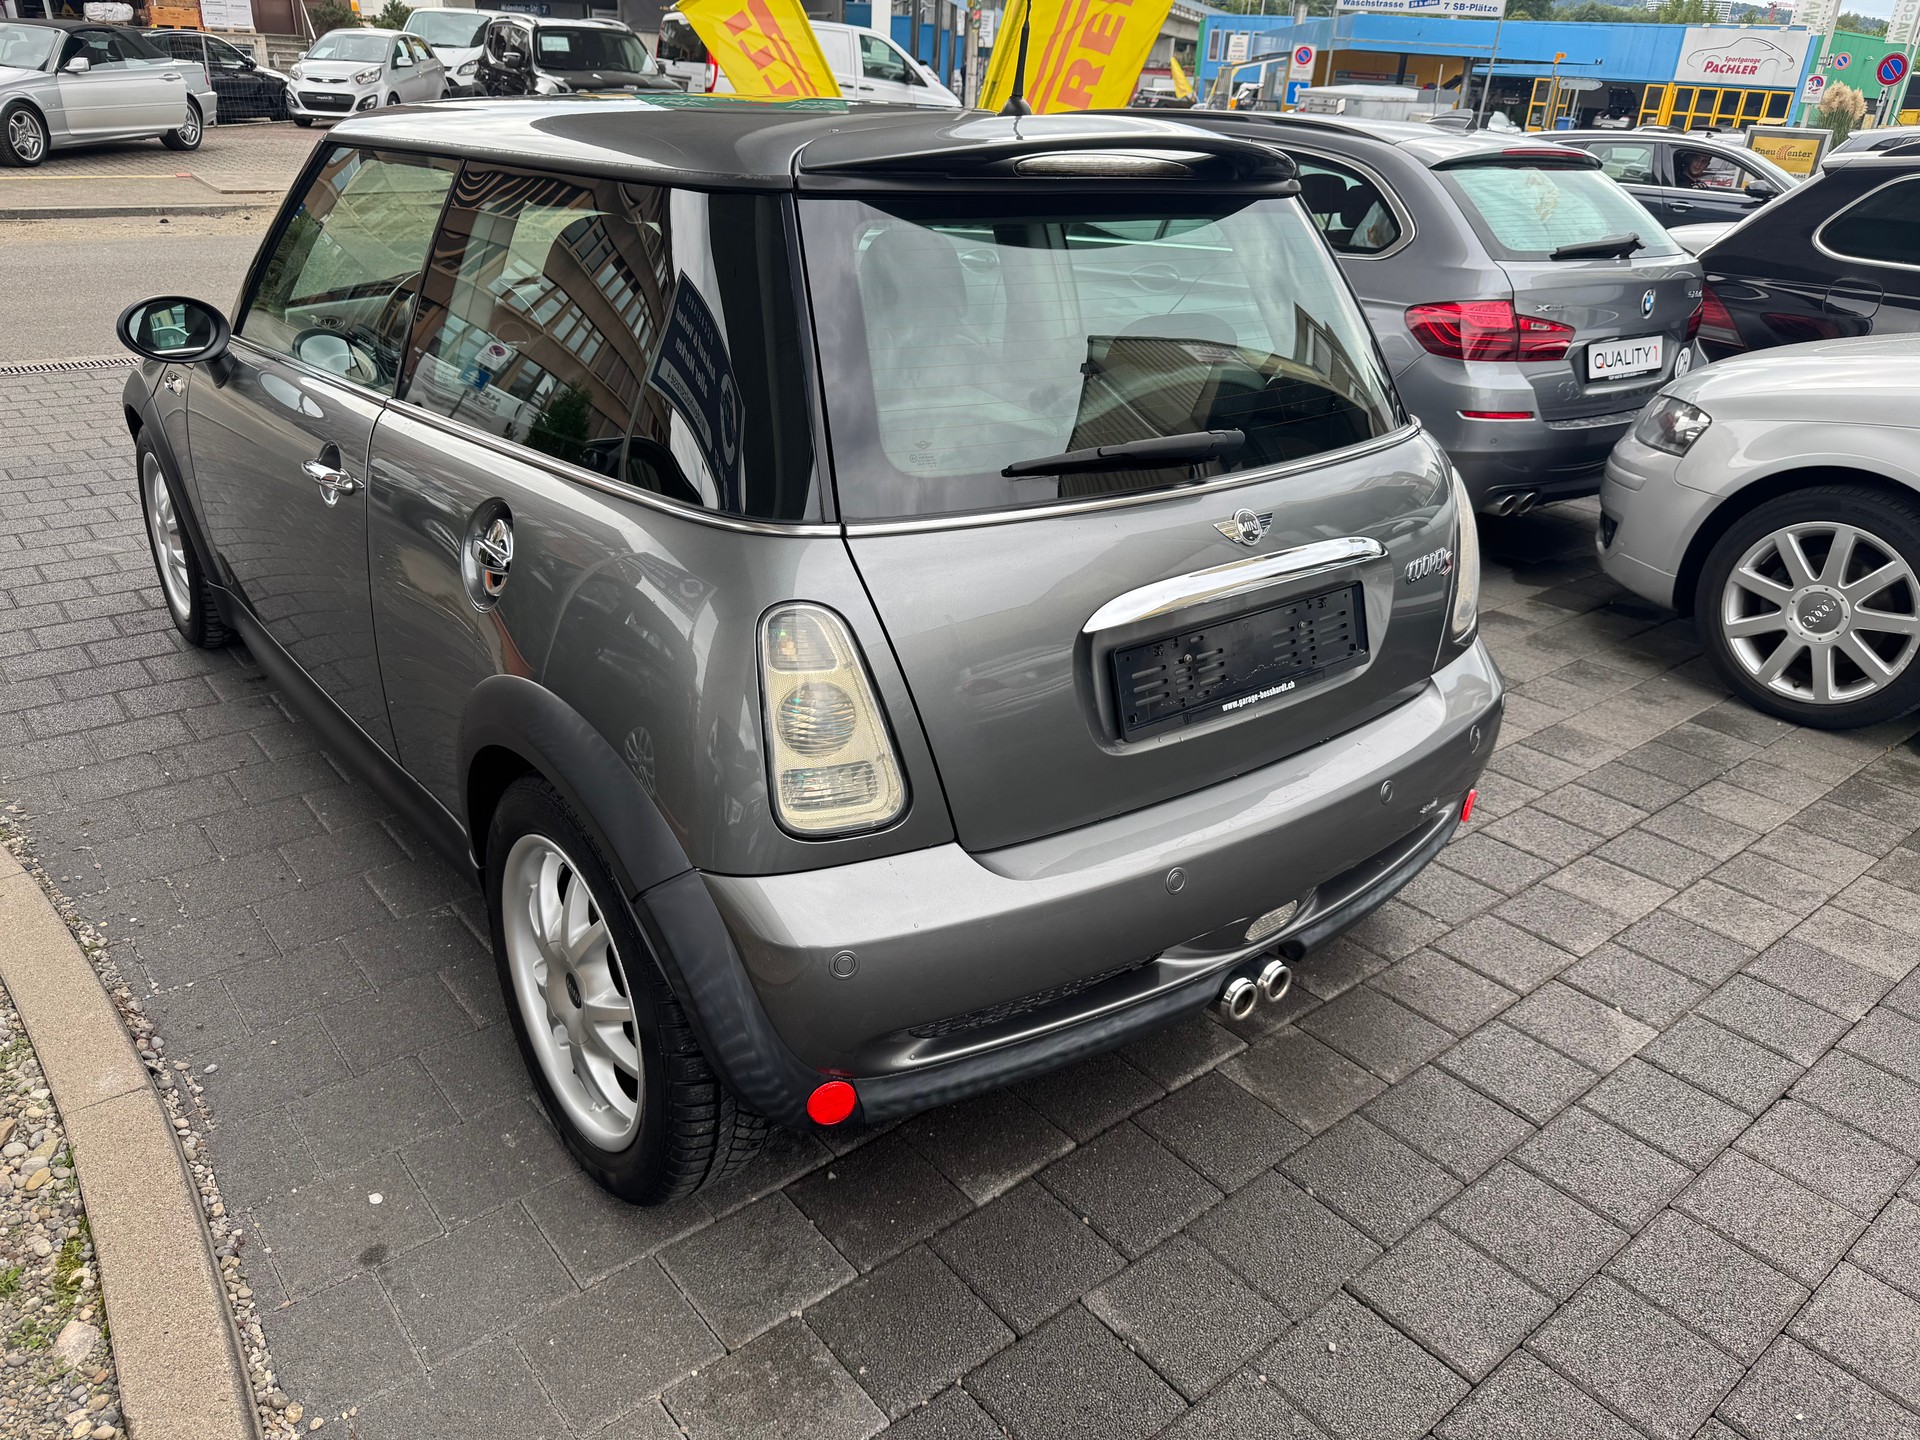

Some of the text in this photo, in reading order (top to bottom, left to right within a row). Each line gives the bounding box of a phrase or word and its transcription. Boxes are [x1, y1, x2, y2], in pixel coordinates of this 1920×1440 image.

[1444, 2, 1450, 10] 7
[1453, 2, 1498, 12] SB-Plätze
[1725, 56, 1761, 65] Sportgarage
[1703, 60, 1758, 75] PACHLER
